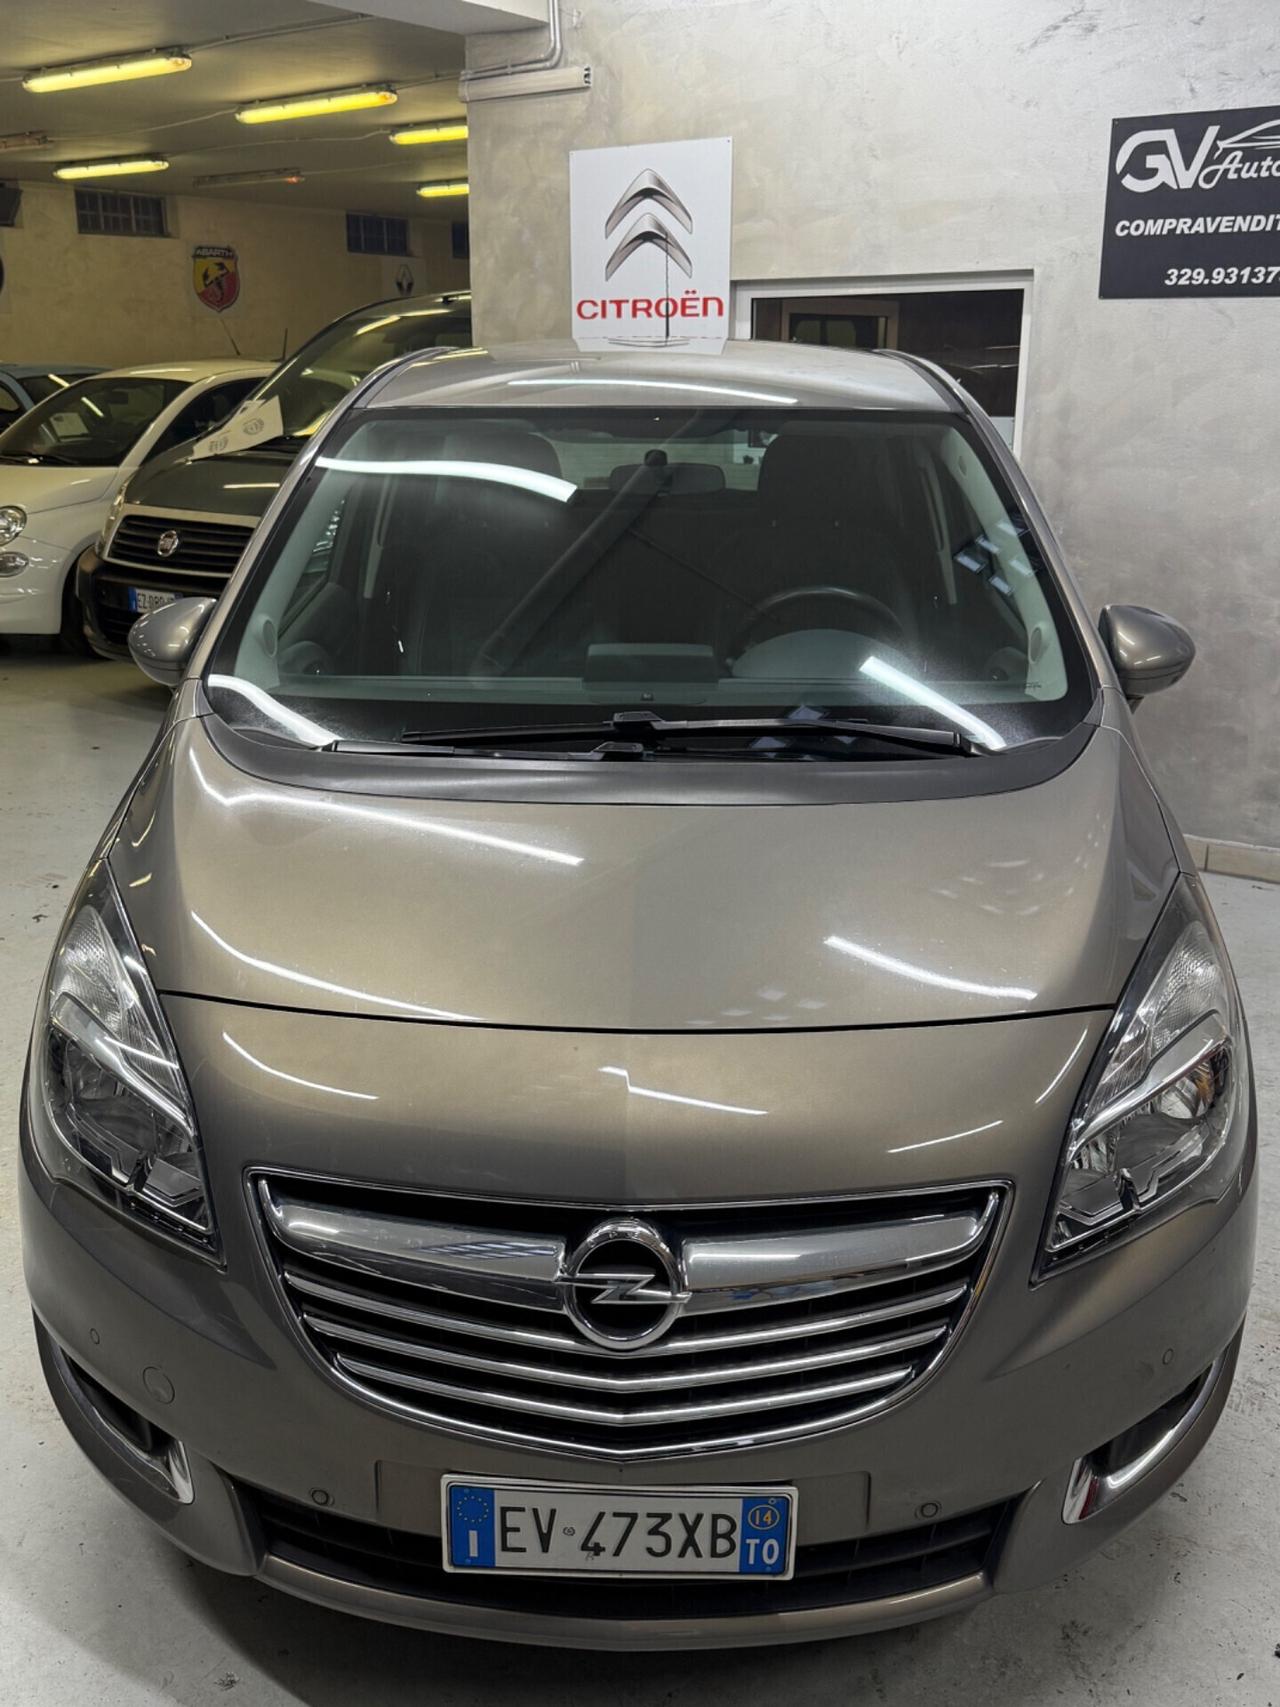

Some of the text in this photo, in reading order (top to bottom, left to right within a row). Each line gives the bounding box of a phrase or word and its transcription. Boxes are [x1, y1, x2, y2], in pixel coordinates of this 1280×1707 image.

[1115, 125, 1221, 193] GV
[1164, 266, 1280, 286] 329.93137
[755, 1510, 772, 1525] 14
[500, 1506, 738, 1559] EV 473XB
[746, 1538, 779, 1565] TO
